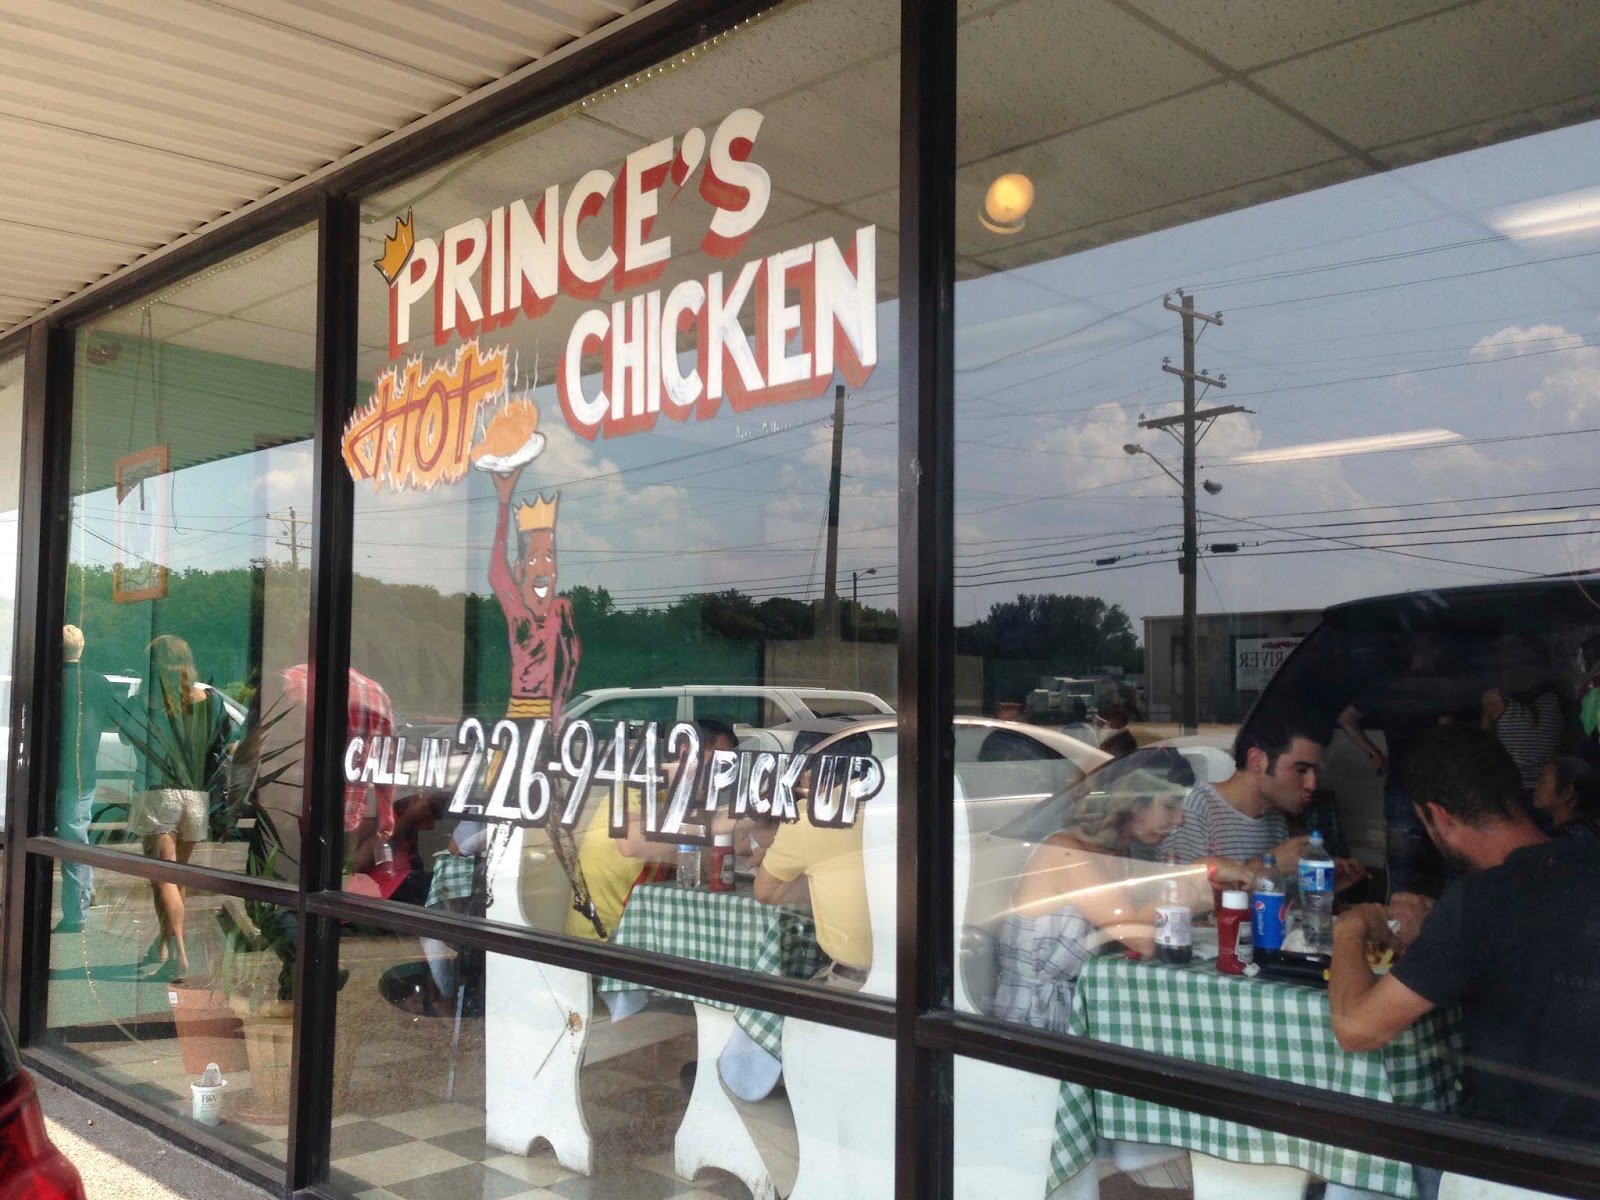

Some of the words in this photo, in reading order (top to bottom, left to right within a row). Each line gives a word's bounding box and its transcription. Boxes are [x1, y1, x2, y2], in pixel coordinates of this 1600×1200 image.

[390, 108, 771, 356] PRINCE'S
[559, 224, 877, 438] CHICKEN
[344, 735, 411, 784] CALL
[417, 736, 451, 788] IN
[449, 716, 703, 836] 226-9442
[706, 750, 806, 820] PICK
[812, 754, 884, 825] UP
